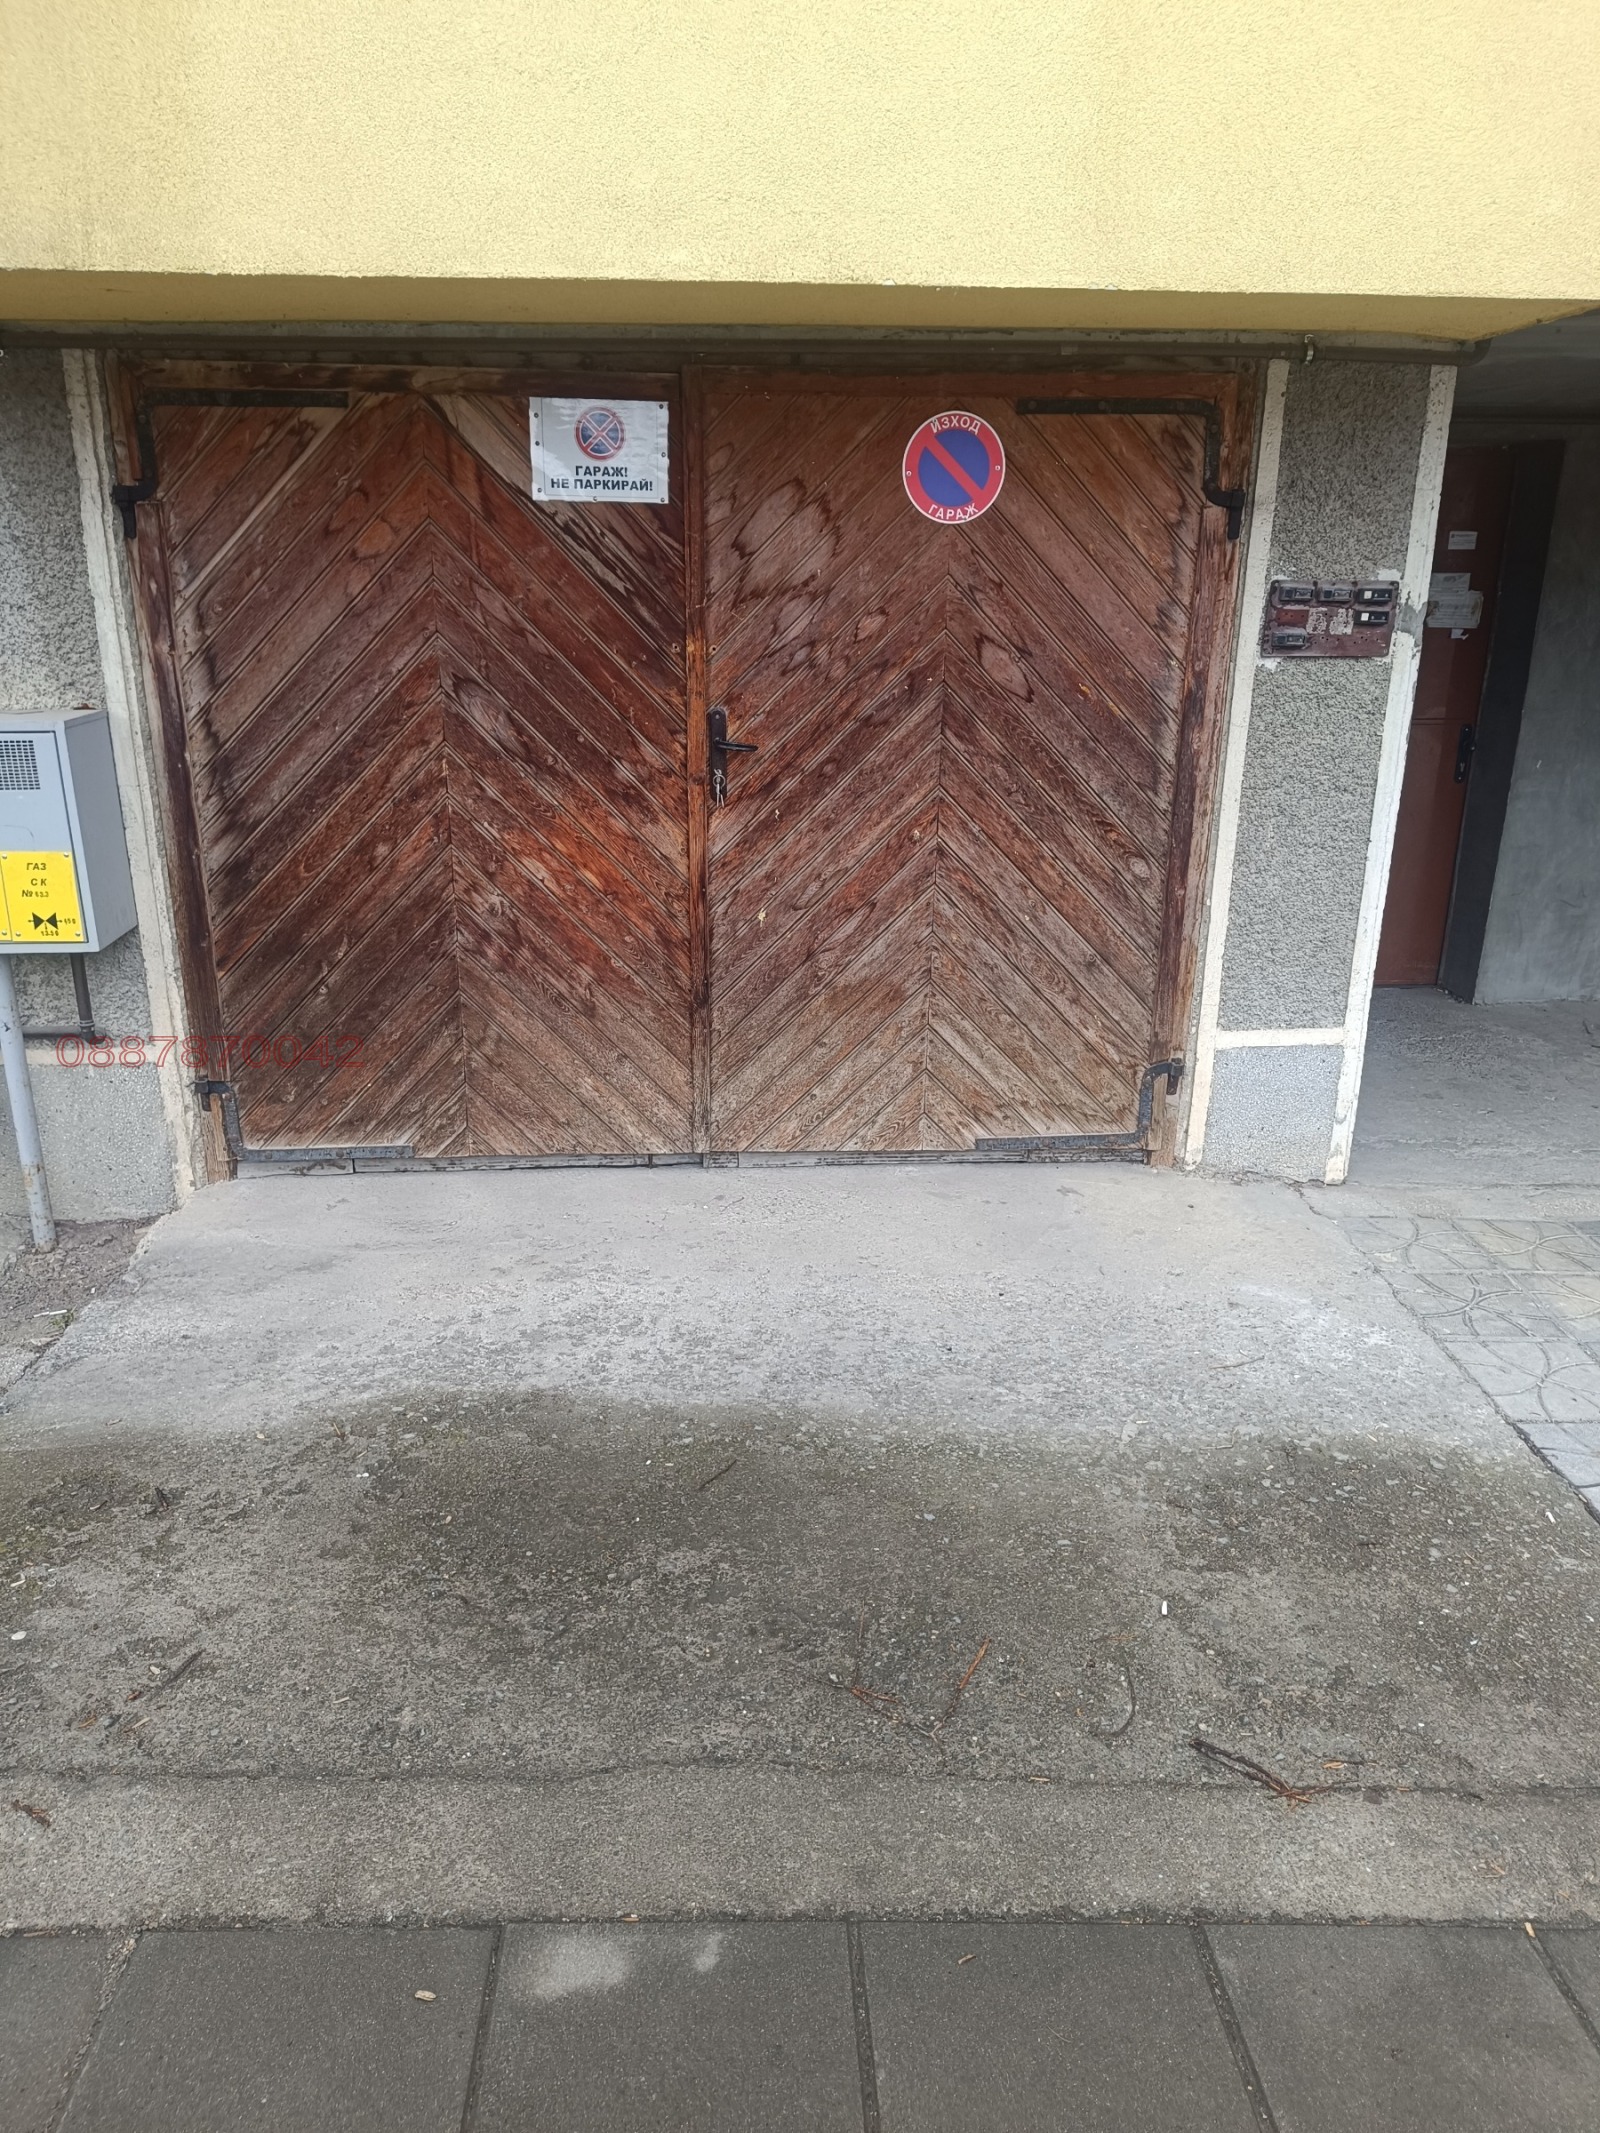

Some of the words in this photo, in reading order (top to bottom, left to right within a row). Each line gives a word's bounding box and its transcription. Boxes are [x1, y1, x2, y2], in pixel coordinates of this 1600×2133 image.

[930, 415, 981, 435] ИЗХОД
[575, 465, 628, 477] ГАРАЖ!
[551, 478, 569, 489] НЕ
[574, 478, 653, 491] ПАРКИРАЙ!
[928, 502, 979, 520] ГАРАЖ
[26, 862, 47, 871] ГАЗ
